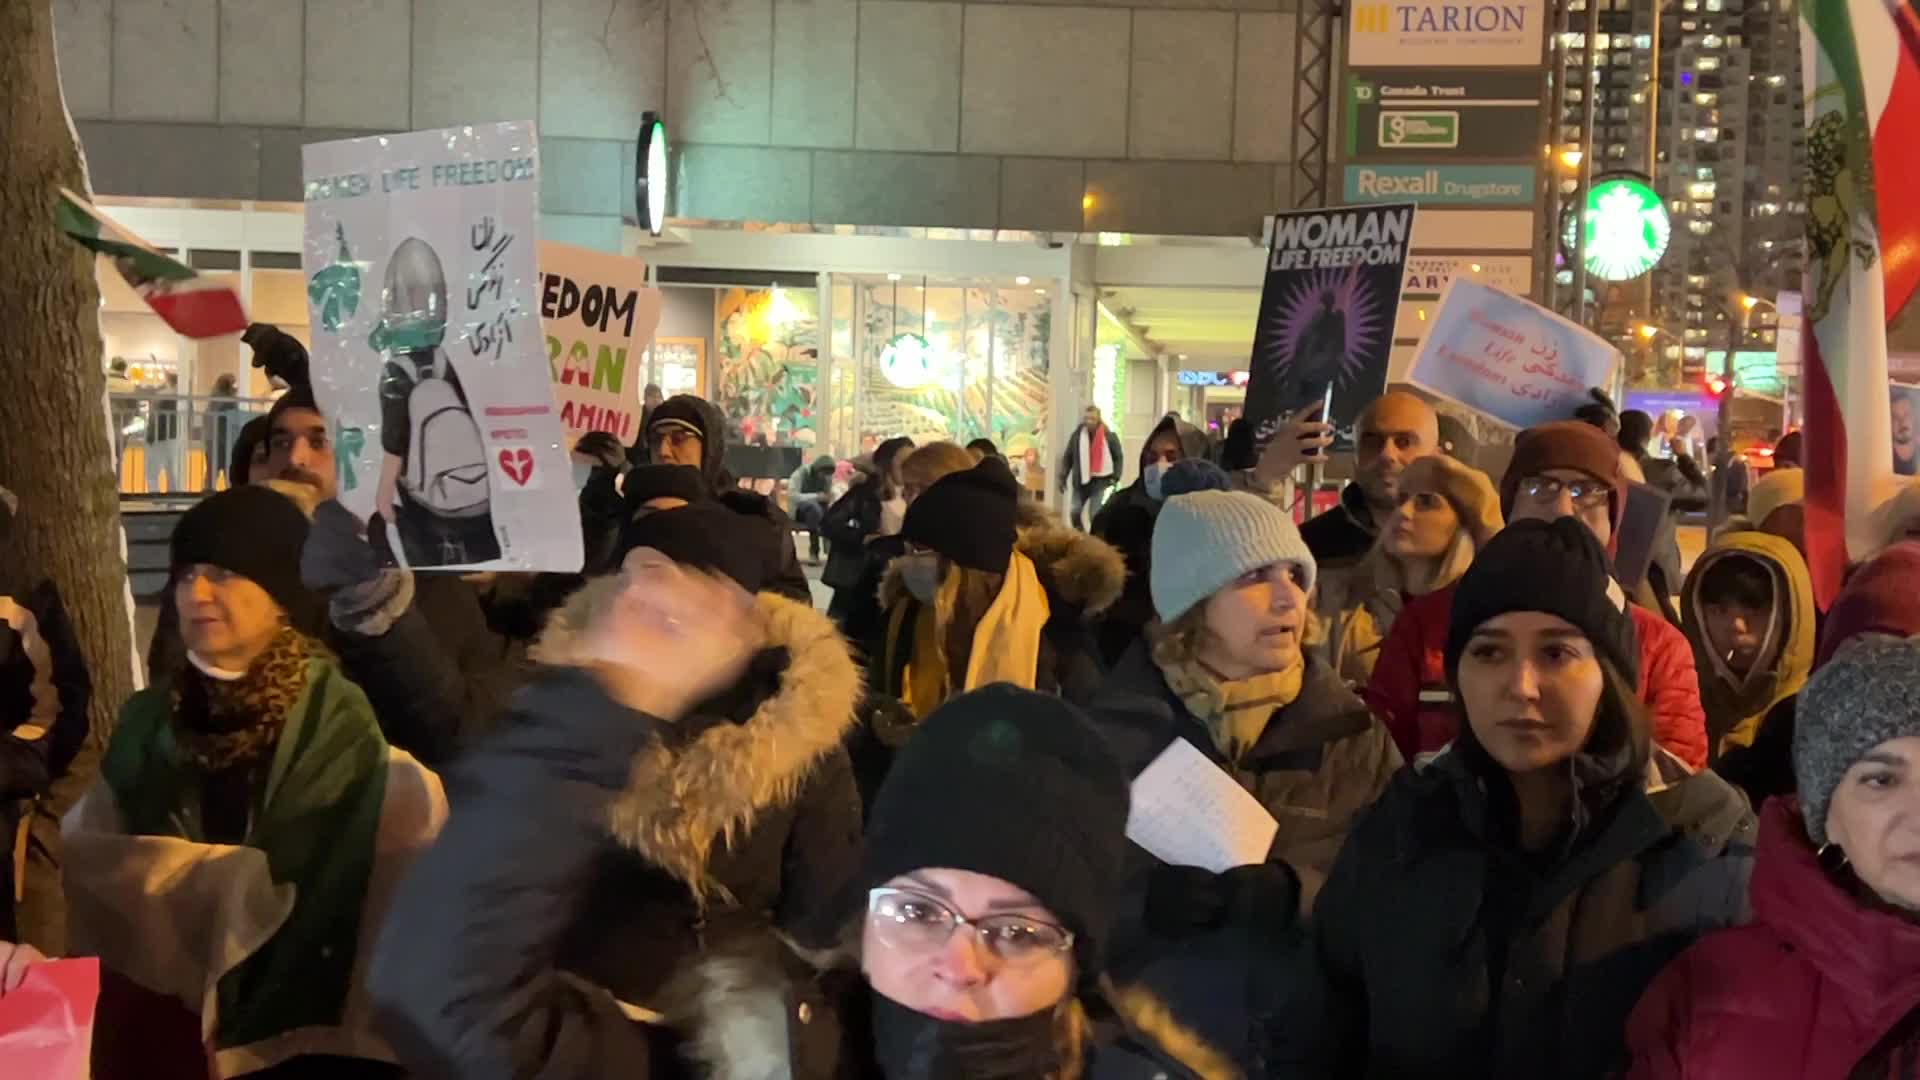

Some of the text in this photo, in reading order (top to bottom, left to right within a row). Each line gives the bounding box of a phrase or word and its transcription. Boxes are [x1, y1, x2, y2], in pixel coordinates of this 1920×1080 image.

[1397, 5, 1526, 32] TARION
[1359, 169, 1522, 198] Rexall Drugstore
[1274, 209, 1408, 249] WOMAN
[1271, 248, 1313, 271] LIFE
[1311, 244, 1401, 269] FREEDOM
[560, 400, 631, 438] AMINI
